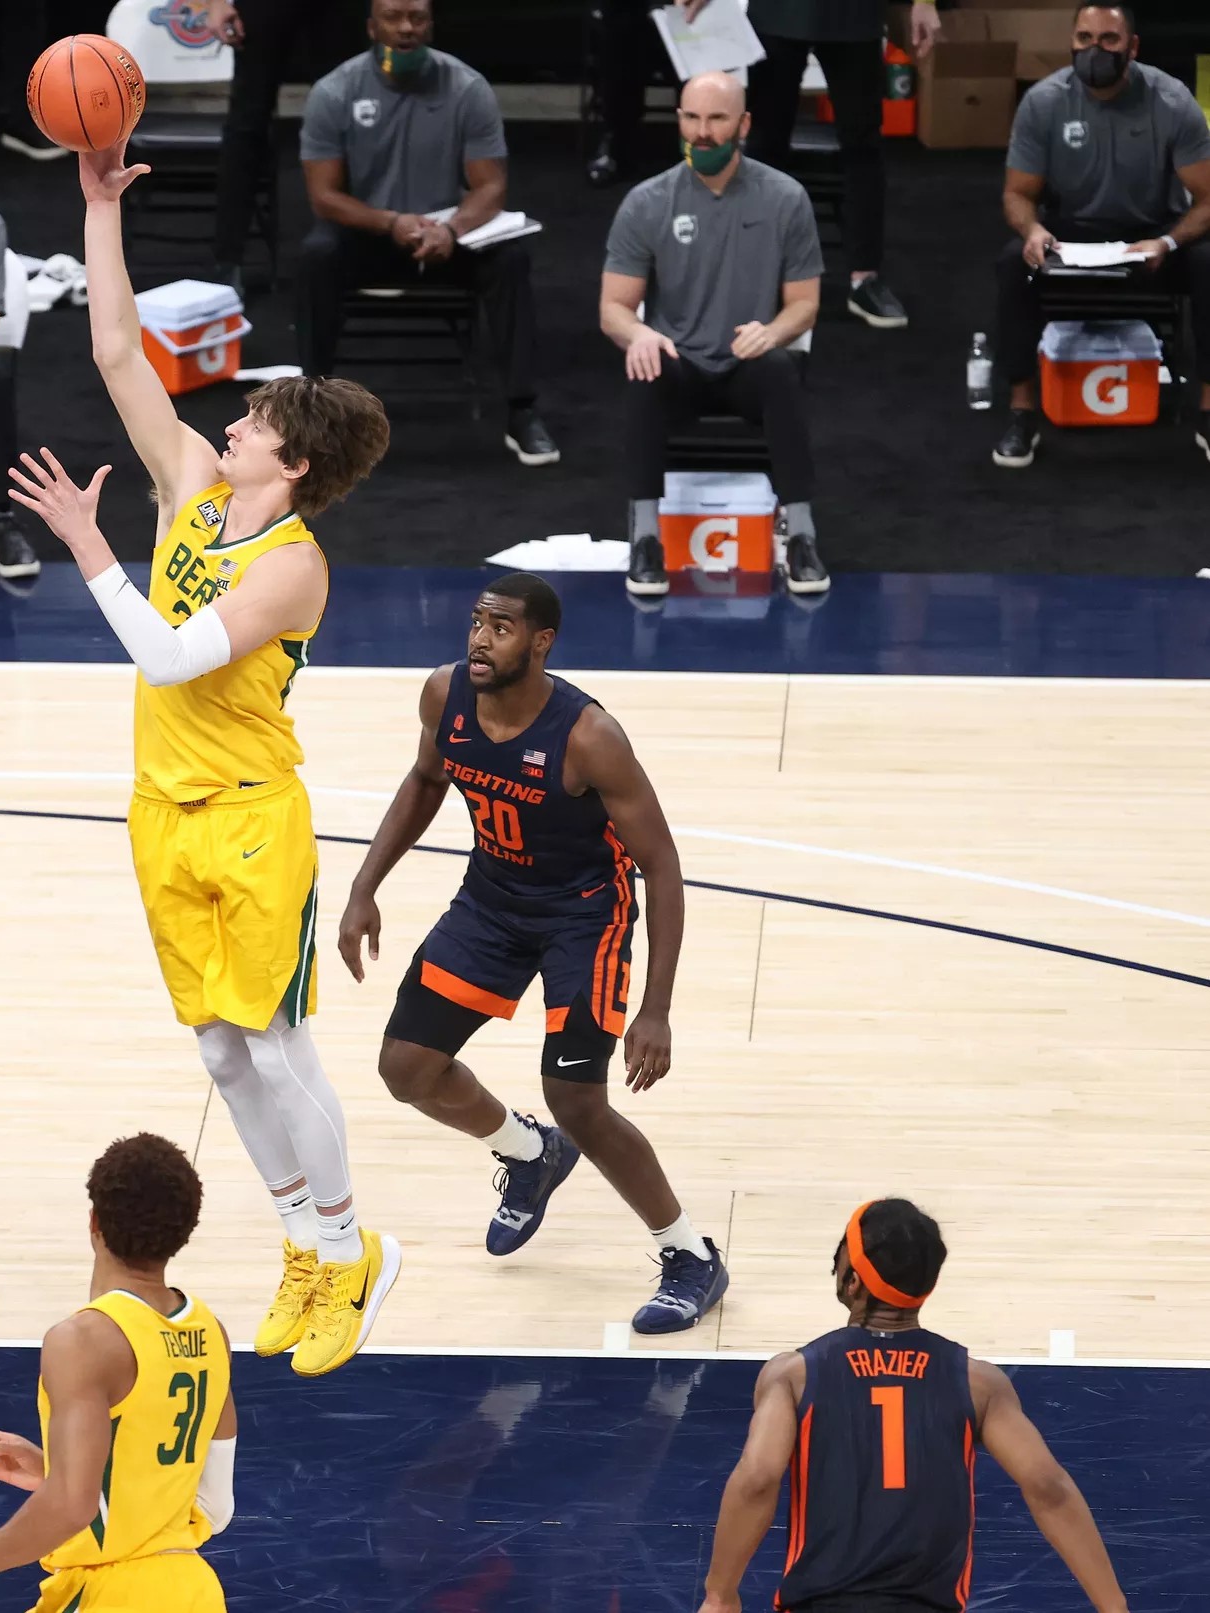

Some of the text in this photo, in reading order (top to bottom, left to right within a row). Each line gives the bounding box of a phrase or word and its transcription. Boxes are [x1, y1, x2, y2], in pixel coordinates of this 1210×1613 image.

[1082, 364, 1129, 415] G
[198, 501, 221, 526] ONE
[689, 516, 738, 572] G
[444, 757, 547, 805] FIGHTING
[464, 788, 524, 851] 20
[845, 1348, 930, 1379] FRAZIER
[156, 1369, 208, 1466] 31
[870, 1386, 906, 1489] 1
